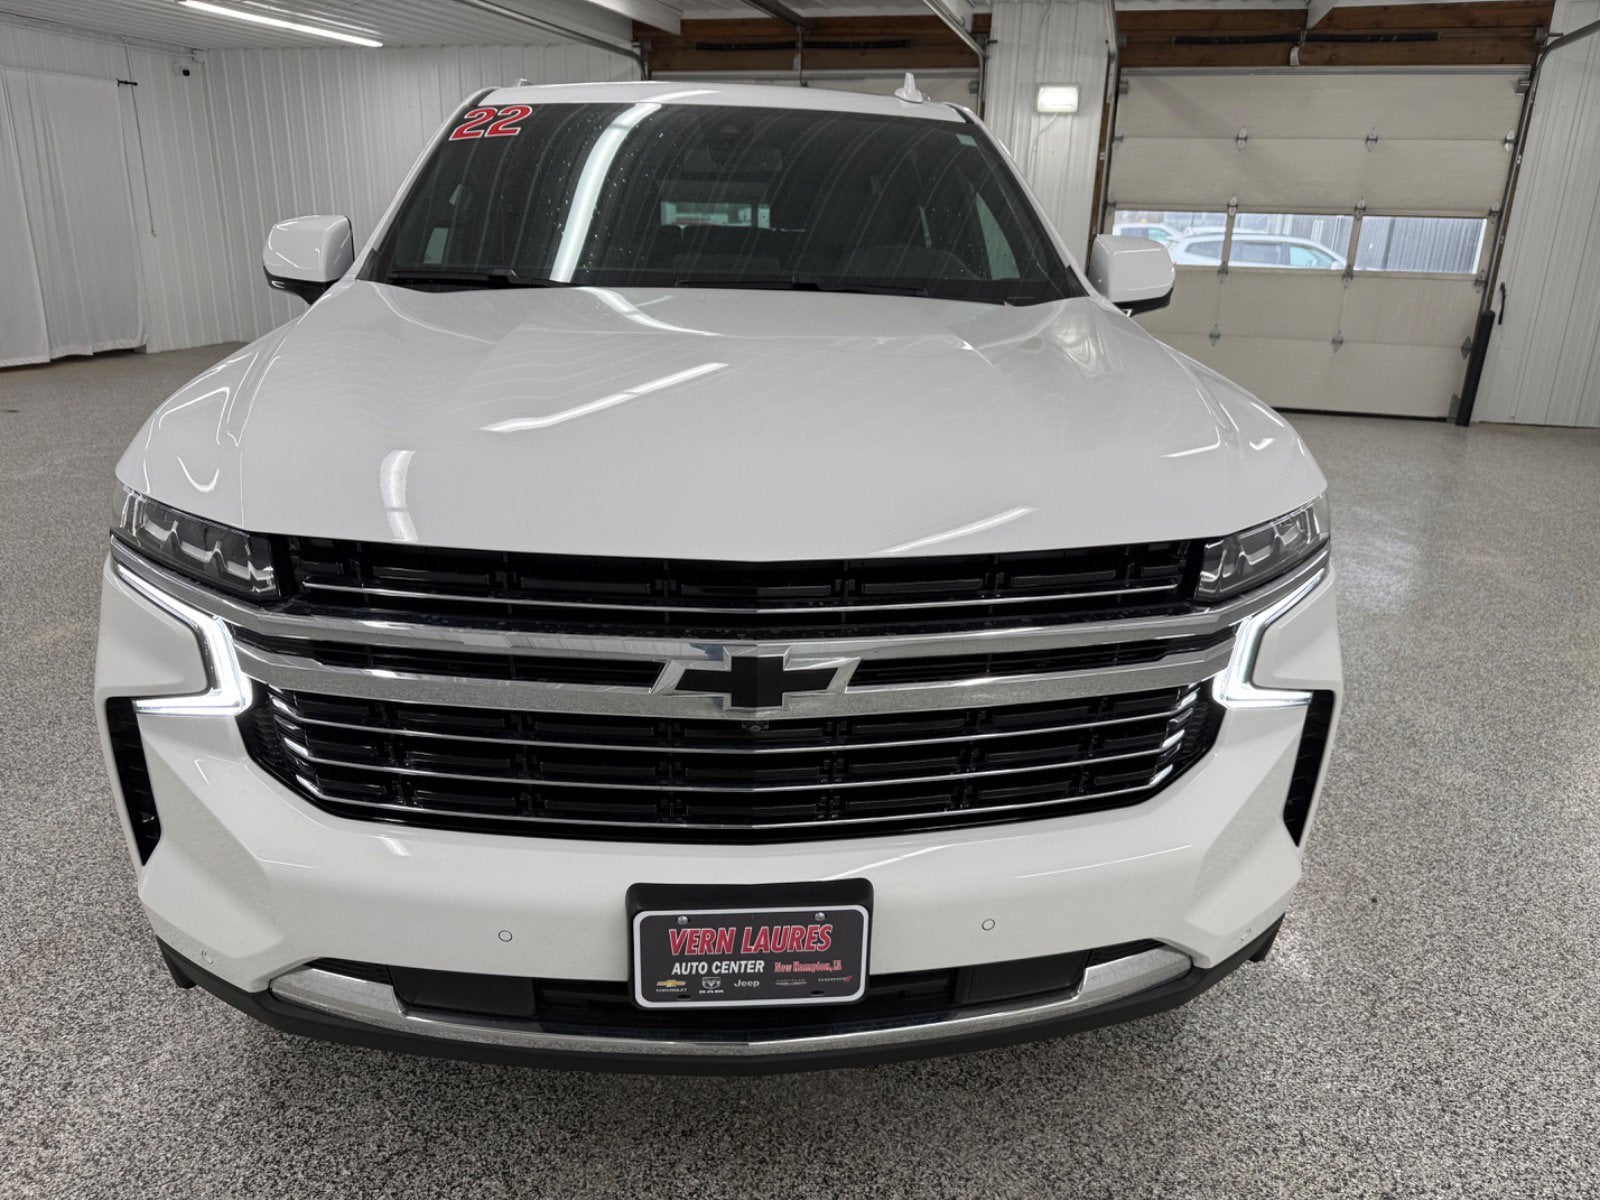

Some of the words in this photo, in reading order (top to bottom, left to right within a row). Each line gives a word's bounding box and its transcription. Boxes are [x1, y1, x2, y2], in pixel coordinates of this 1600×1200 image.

[448, 105, 533, 141] 22
[669, 926, 736, 955] VERN
[740, 924, 833, 953] LAURES
[671, 961, 708, 975] AUTO
[712, 960, 765, 974] CENTER
[774, 961, 792, 973] New
[733, 978, 760, 988] Jeep
